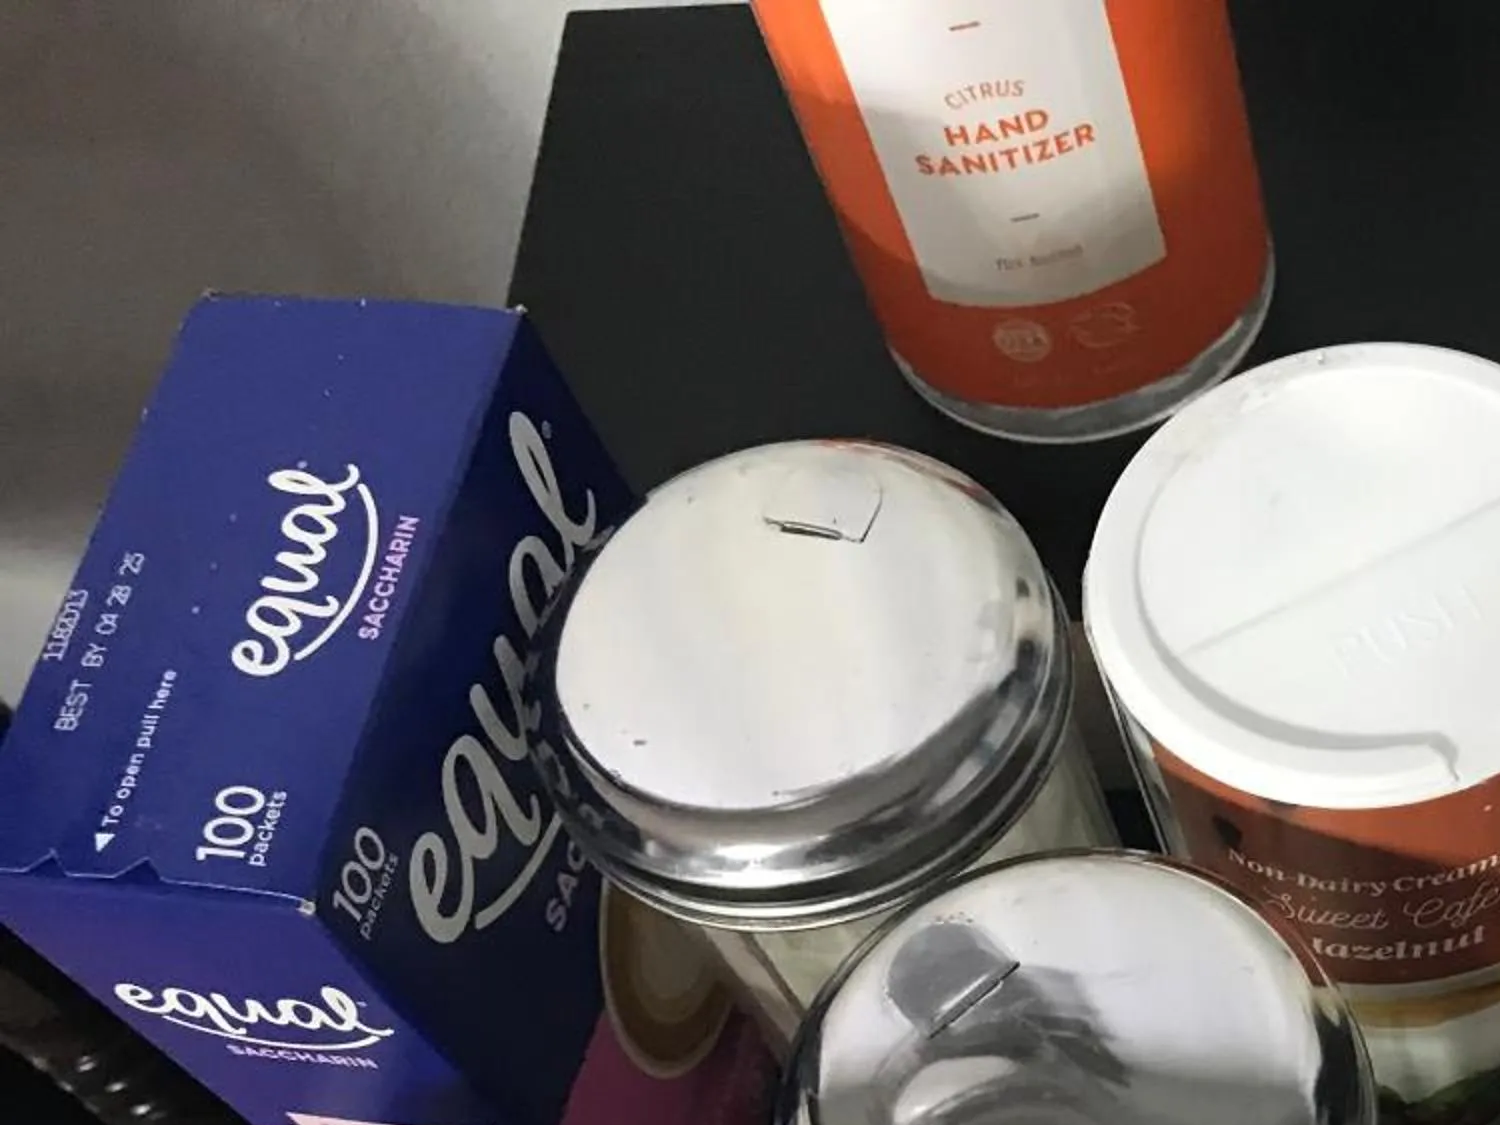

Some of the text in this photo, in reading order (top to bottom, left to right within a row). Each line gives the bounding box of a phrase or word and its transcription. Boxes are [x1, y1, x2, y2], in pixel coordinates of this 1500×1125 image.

[943, 79, 1026, 110] CITRUS
[943, 109, 1050, 147] HAND
[914, 123, 1096, 176] SANITIZER
[231, 463, 362, 677] equal
[358, 515, 420, 641] SACCHARIN
[54, 552, 145, 731] BEST BY 04 28 25
[102, 669, 177, 827] To open pull here
[196, 785, 265, 861] 100
[249, 791, 287, 867] packets
[332, 827, 385, 922] 100
[360, 853, 400, 940] packets
[1229, 848, 1387, 896] Non-Dairy
[1261, 885, 1389, 929] Sweet
[114, 983, 395, 1038] equal
[226, 1044, 379, 1069] SACCHARIN
